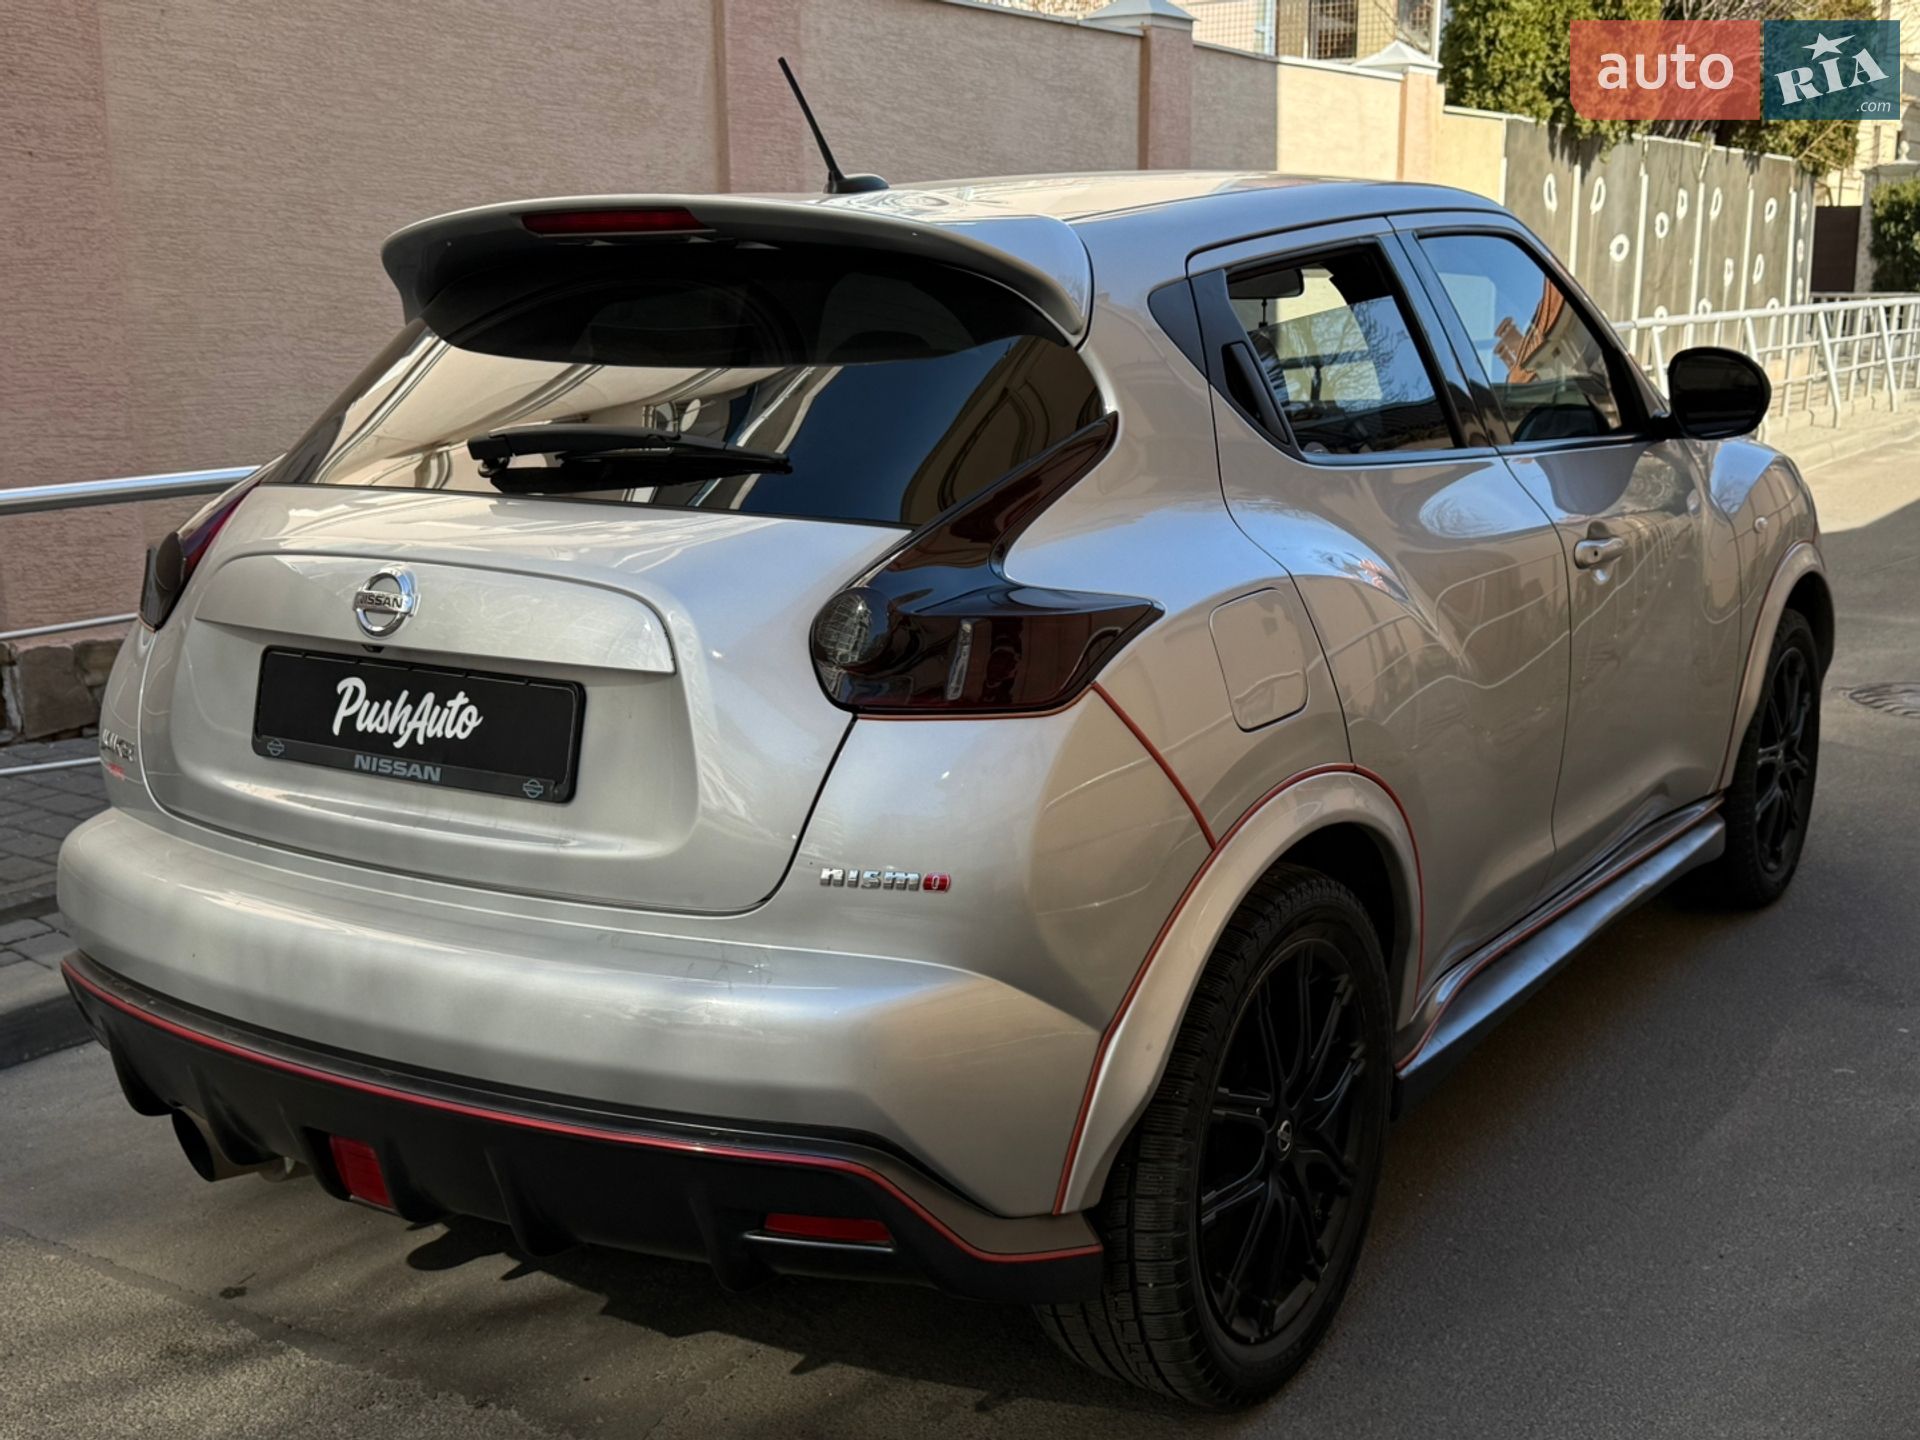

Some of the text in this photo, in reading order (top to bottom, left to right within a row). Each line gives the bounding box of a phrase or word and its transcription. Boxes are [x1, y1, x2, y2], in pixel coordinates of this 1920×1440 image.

[357, 592, 404, 609] NISSAN
[332, 677, 484, 749] PushAuto
[354, 754, 442, 782] NISSAN
